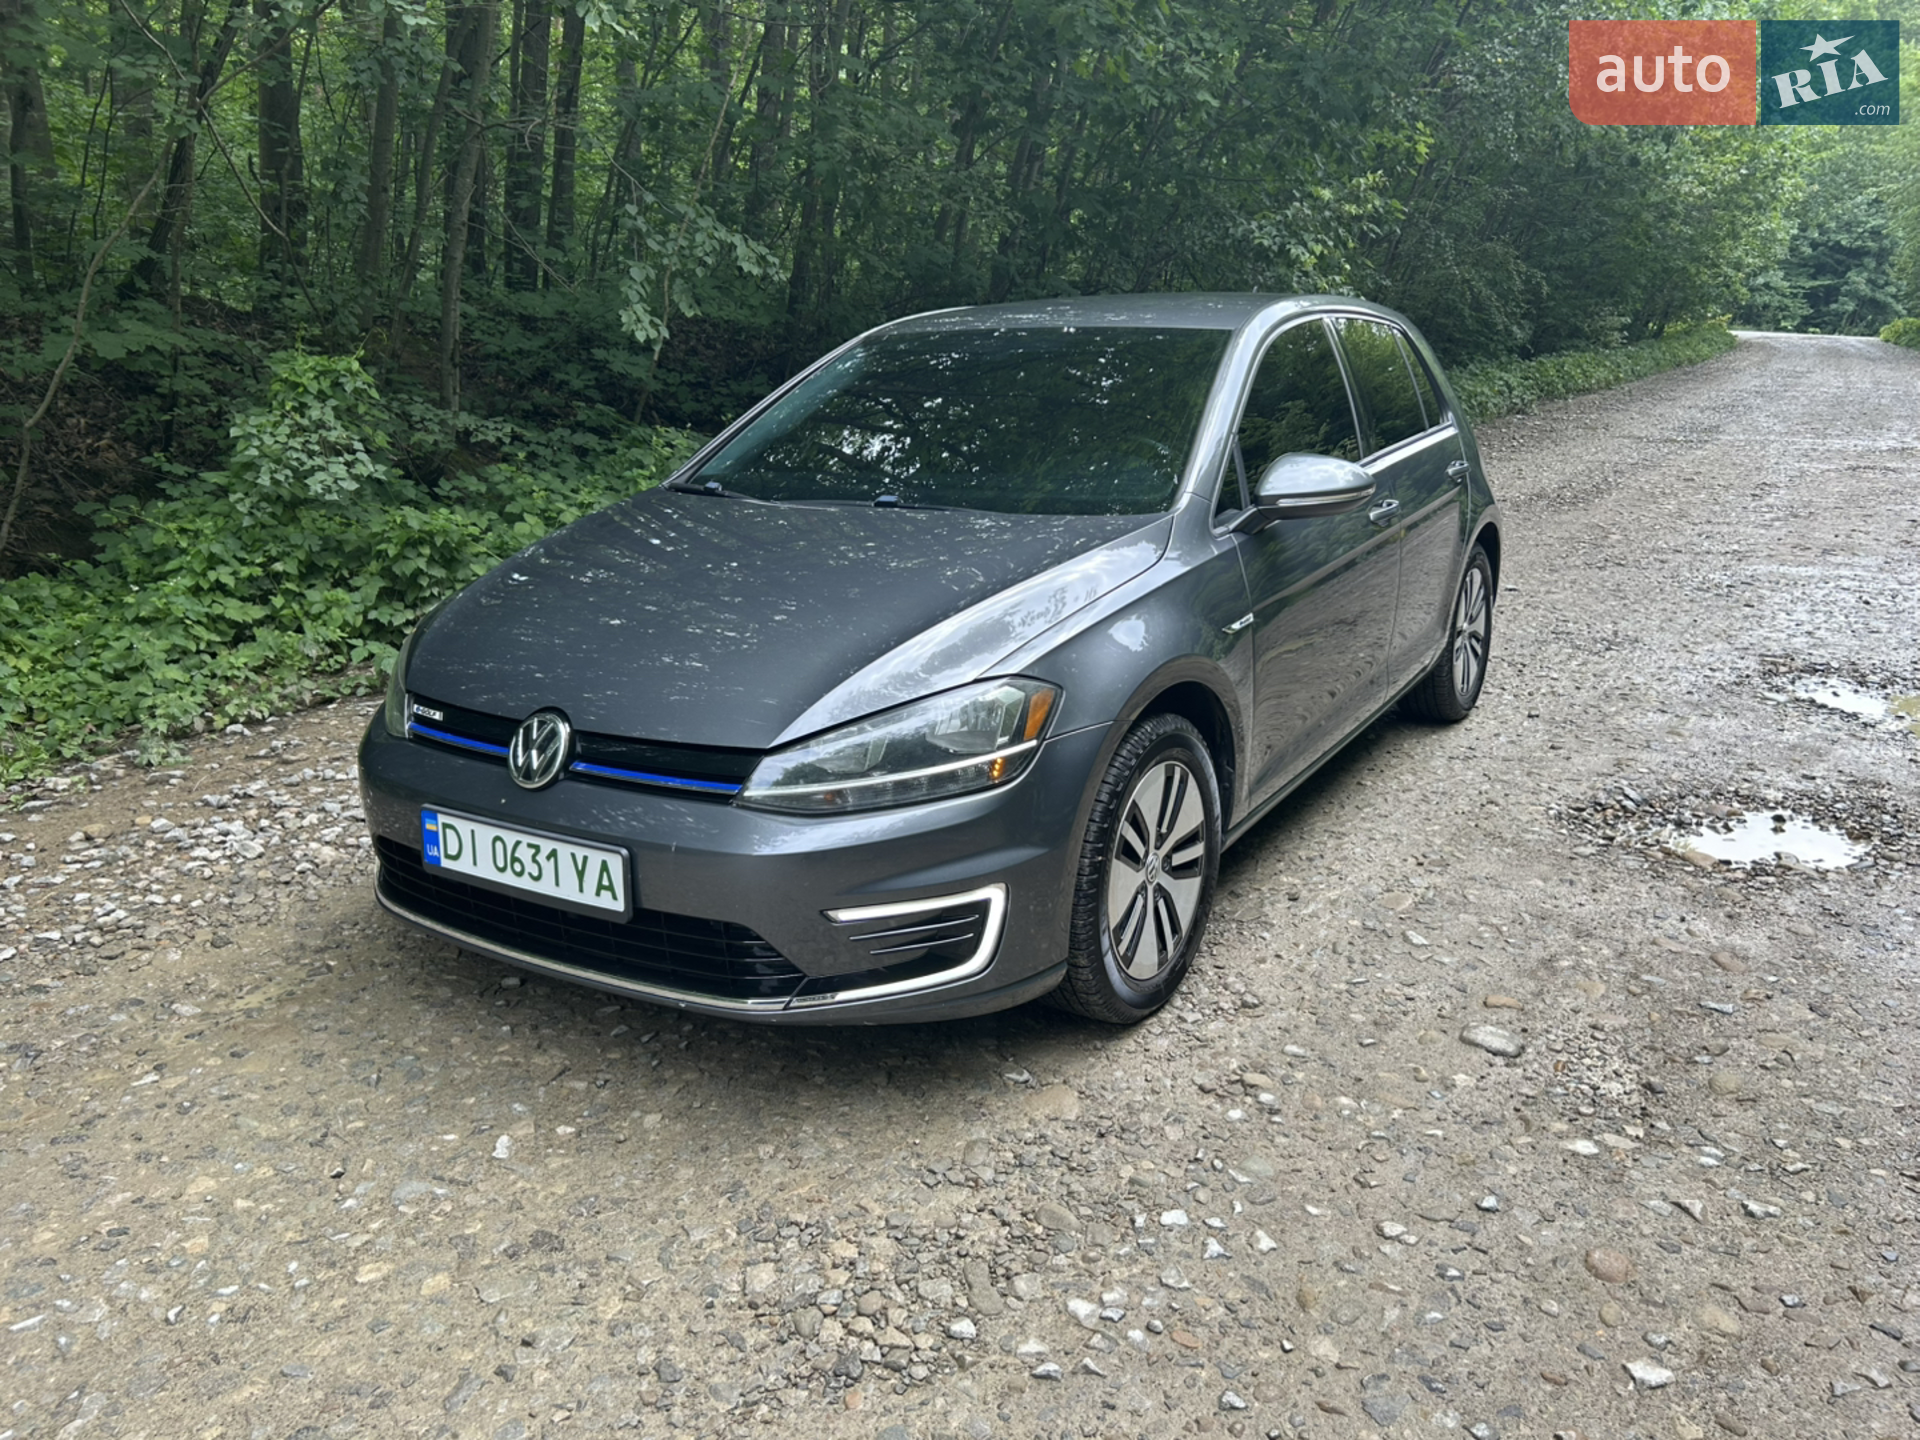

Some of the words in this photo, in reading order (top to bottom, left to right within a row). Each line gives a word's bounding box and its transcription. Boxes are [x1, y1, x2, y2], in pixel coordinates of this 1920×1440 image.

[426, 844, 440, 857] UA
[441, 822, 477, 867] DI
[491, 835, 560, 887] 0631
[570, 852, 618, 901] YA
